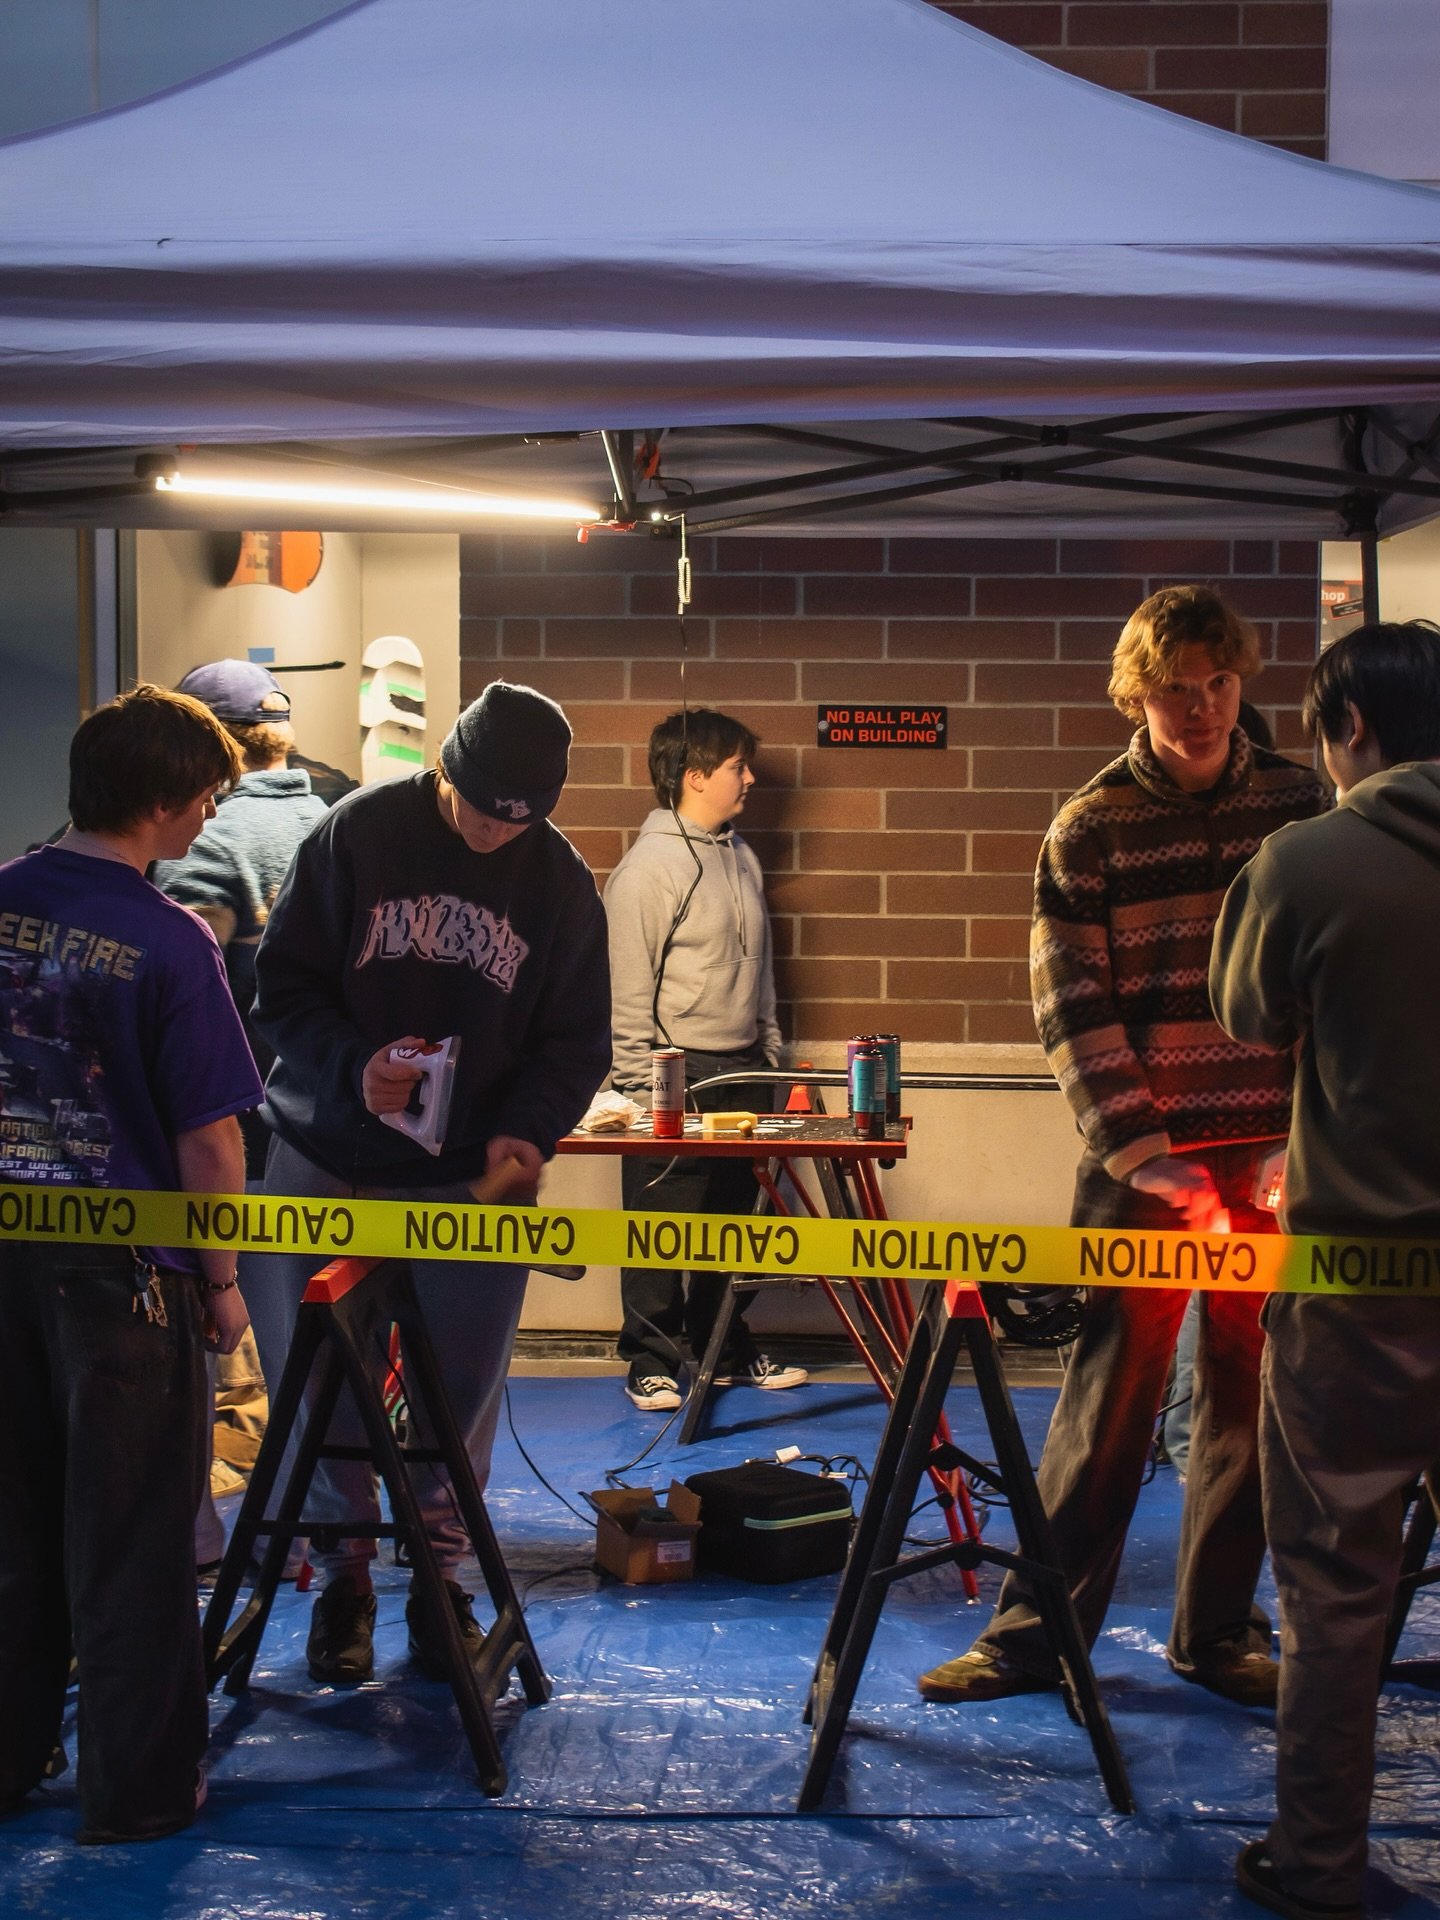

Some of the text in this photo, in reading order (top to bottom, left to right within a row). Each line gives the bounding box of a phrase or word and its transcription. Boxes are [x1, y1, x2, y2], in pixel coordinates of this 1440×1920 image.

[826, 711, 941, 724] NO BALL PLAY
[831, 729, 936, 743] ON BUILDING
[61, 927, 143, 981] FIRE
[653, 1081, 672, 1091] OAT
[187, 1202, 353, 1246] CAUTION
[405, 1210, 576, 1256] CAUTION
[627, 1219, 799, 1264] CAUTION
[852, 1228, 1026, 1273] CAUTION
[1080, 1237, 1256, 1281] CAUTION
[1310, 1244, 1440, 1287] UTION
